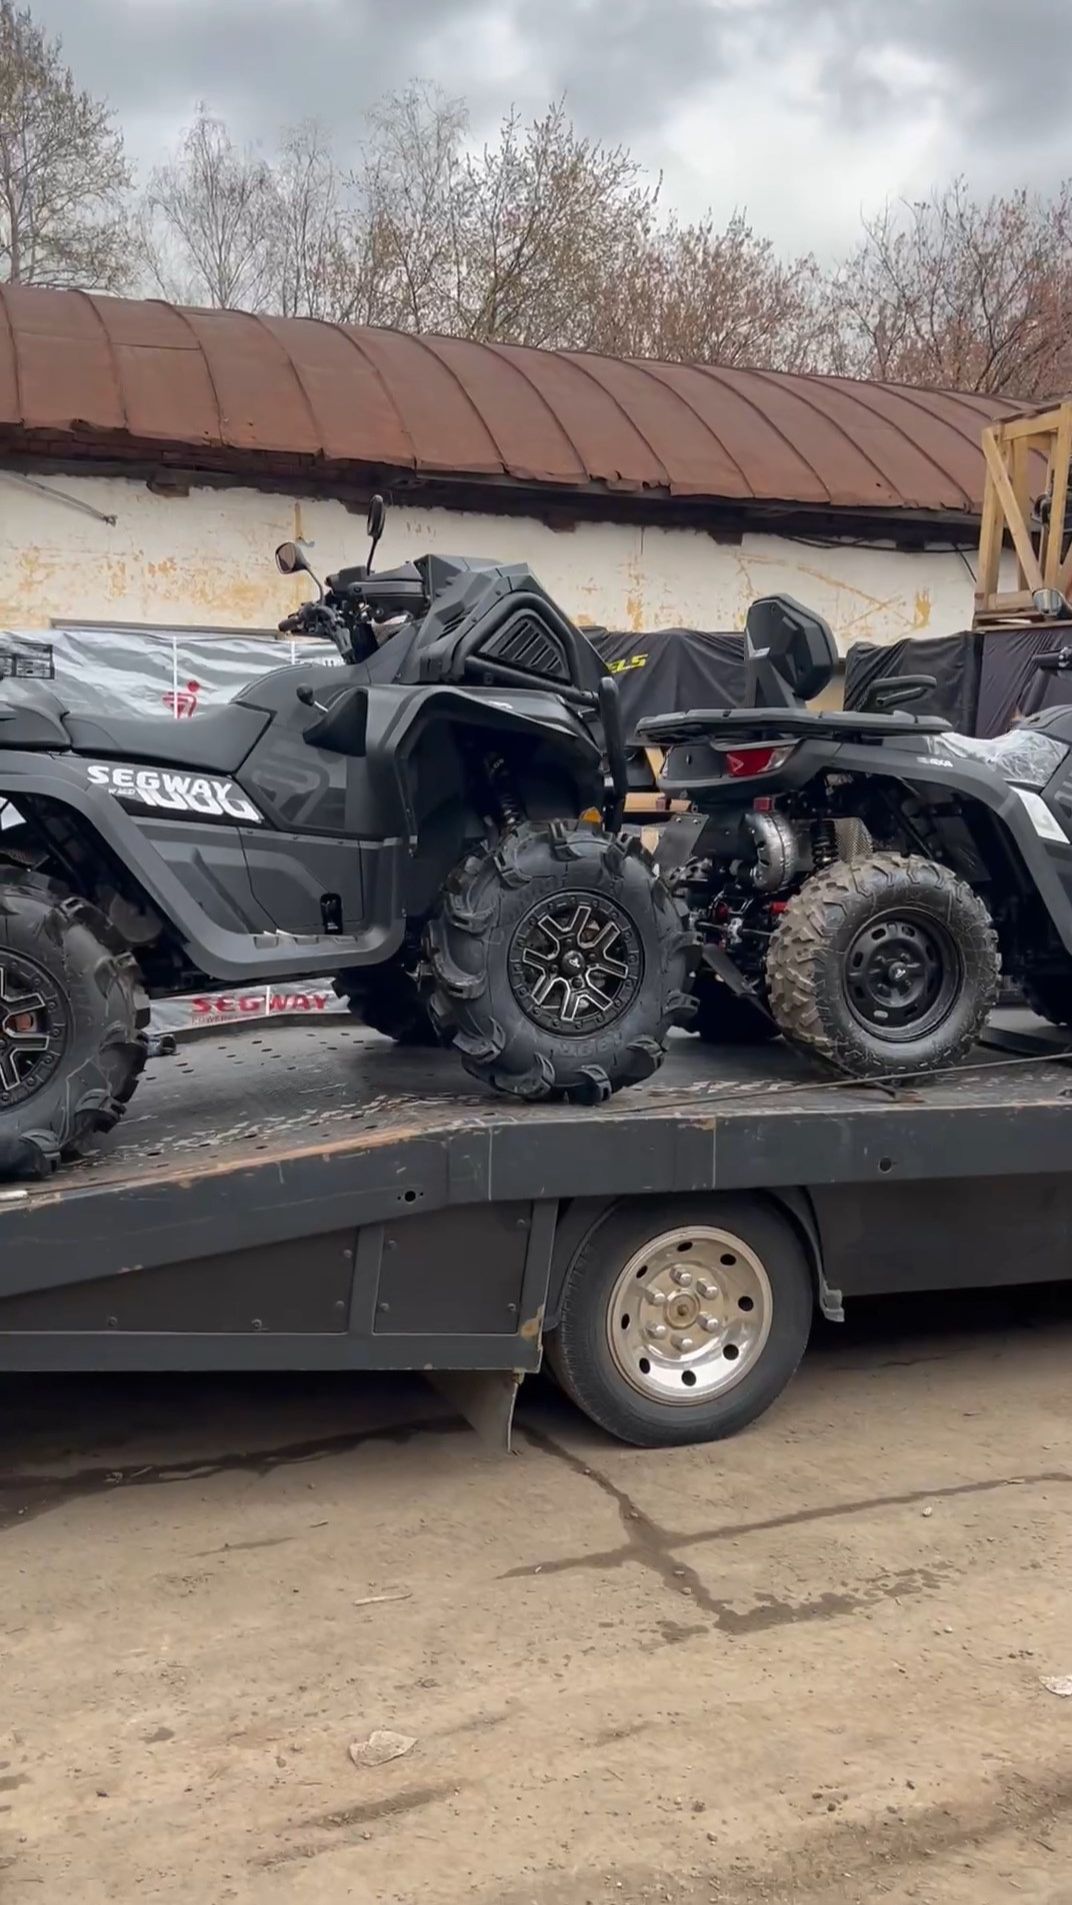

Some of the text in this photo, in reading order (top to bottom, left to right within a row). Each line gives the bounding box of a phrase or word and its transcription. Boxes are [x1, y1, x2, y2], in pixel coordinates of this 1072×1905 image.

[605, 653, 649, 674] ELS
[87, 765, 232, 800] SEGWAY
[191, 994, 329, 1013] SEGWAY
